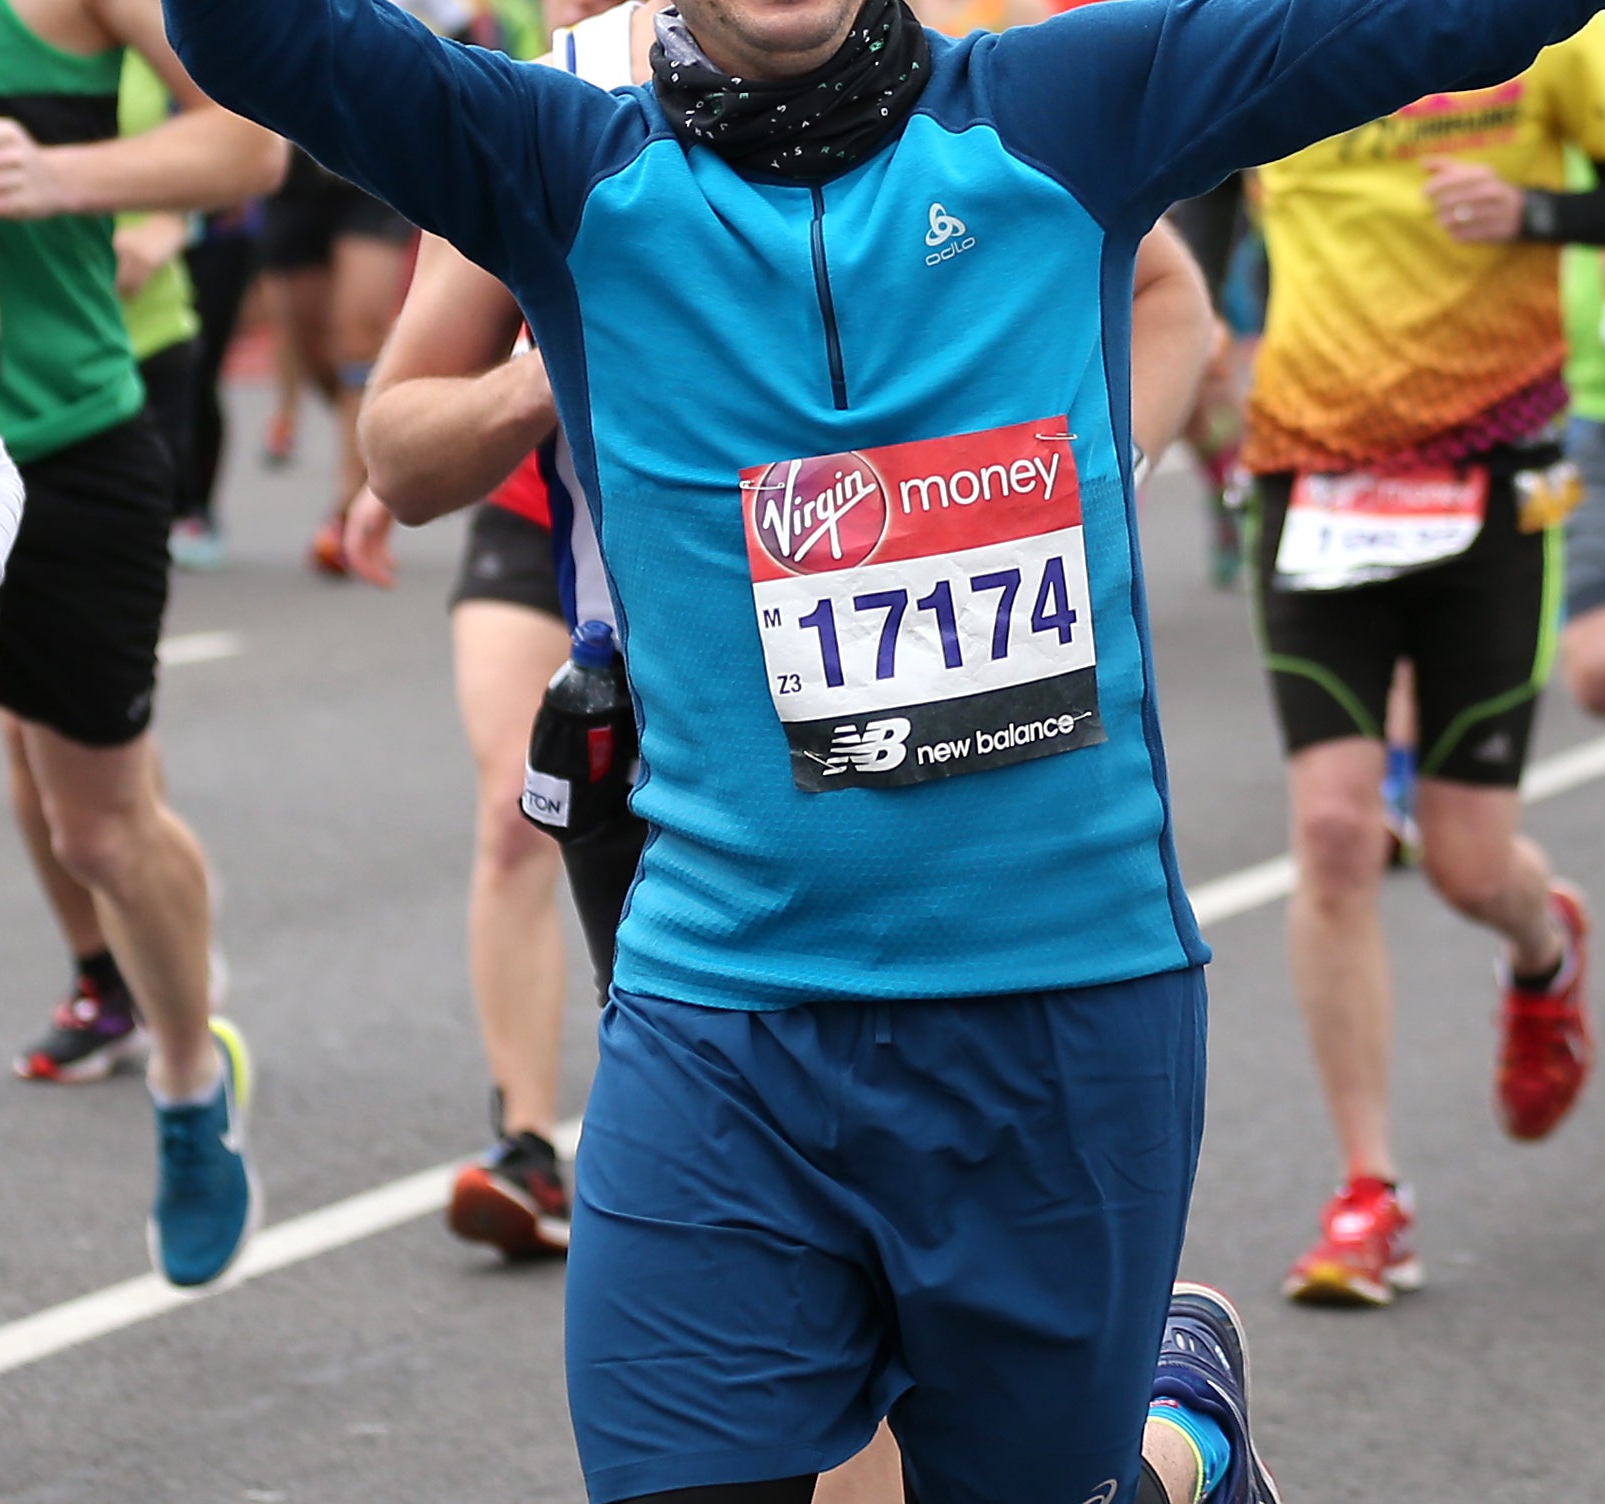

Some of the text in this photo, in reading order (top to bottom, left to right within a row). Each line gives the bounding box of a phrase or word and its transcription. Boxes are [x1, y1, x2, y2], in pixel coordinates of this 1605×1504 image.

[925, 236, 976, 267] odlo
[762, 451, 1061, 563] Virgin money
[762, 607, 782, 630] M
[797, 556, 1077, 691] 17174
[776, 674, 802, 696] Z3
[917, 736, 971, 766] new
[976, 712, 1077, 756] balance
